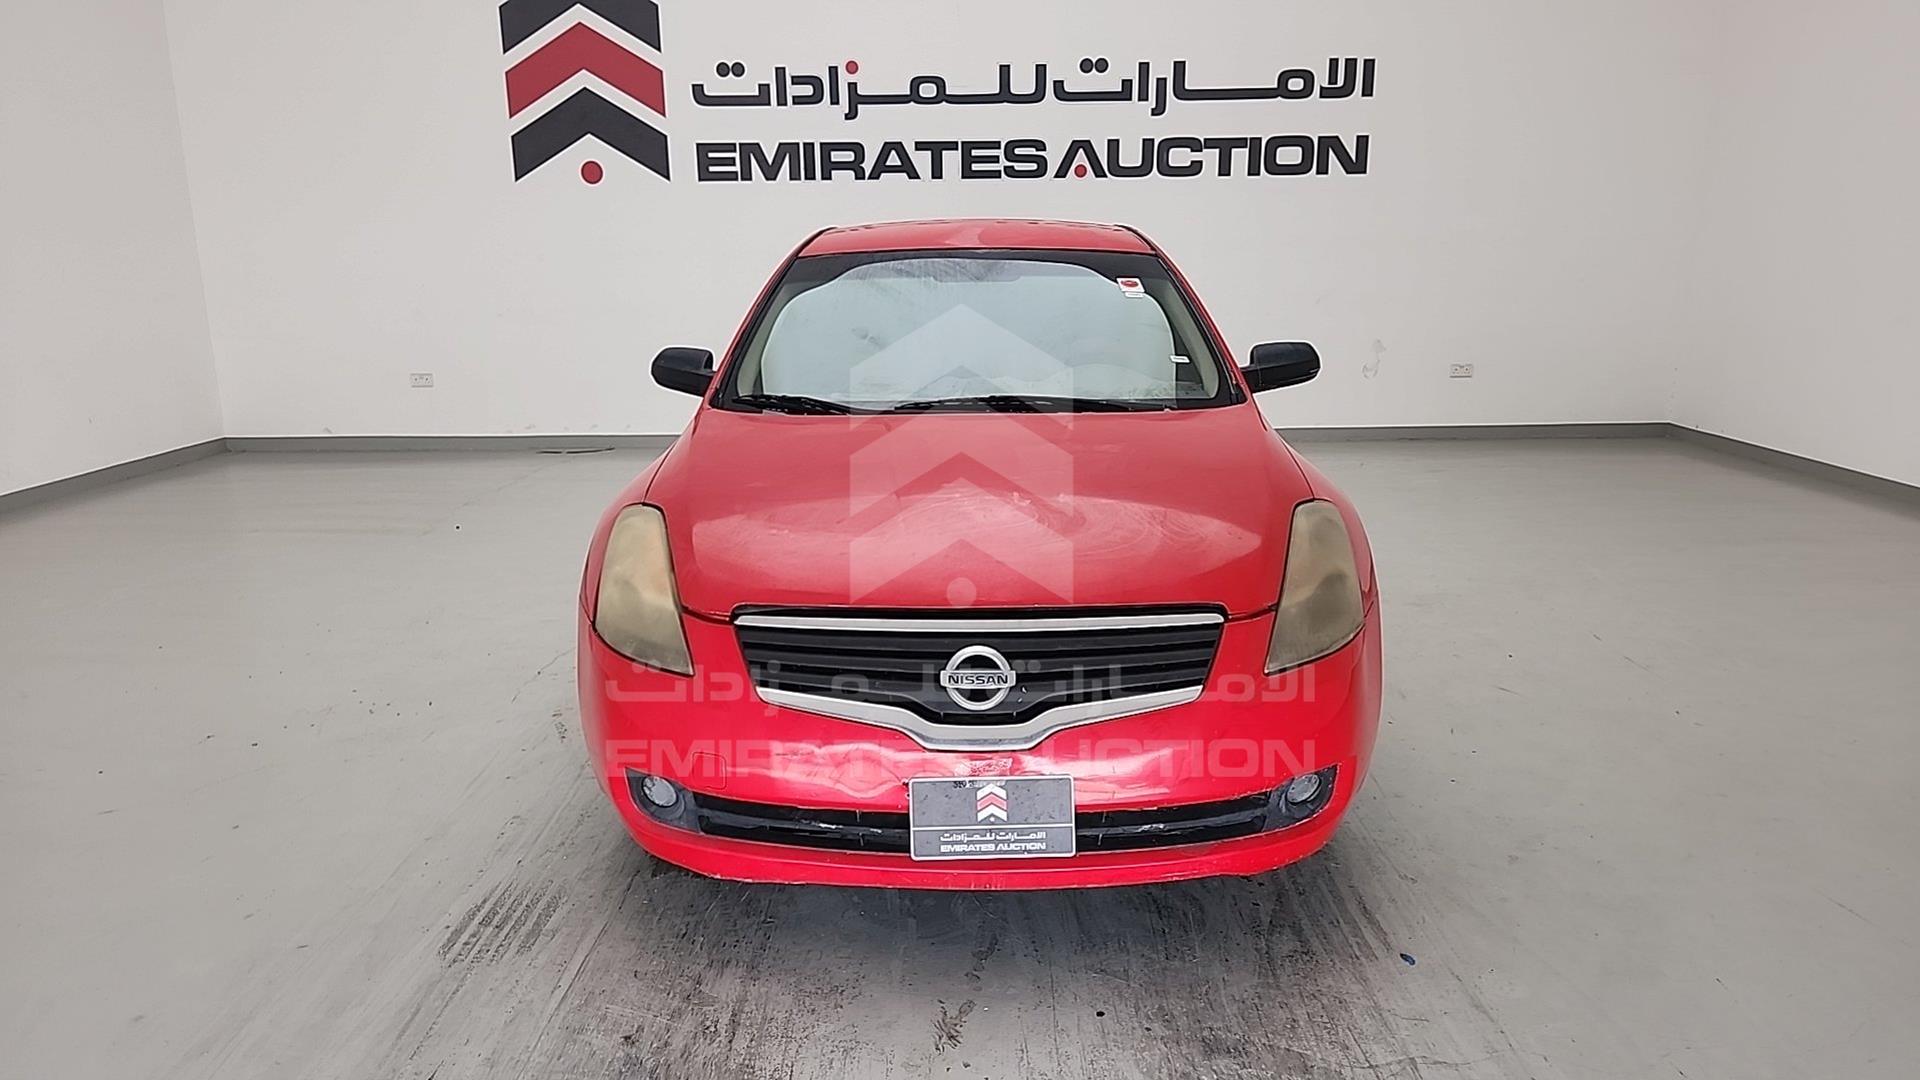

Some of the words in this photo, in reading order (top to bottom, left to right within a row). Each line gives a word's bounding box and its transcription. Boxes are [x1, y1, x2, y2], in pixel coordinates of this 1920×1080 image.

[692, 60, 1046, 120] للمزادات
[696, 139, 1048, 182] EMIRATES
[1053, 135, 1370, 179] AUCTION
[947, 673, 1008, 685] NISSAN
[940, 843, 995, 853] EMIRATES
[996, 842, 1046, 851] AUCTION
